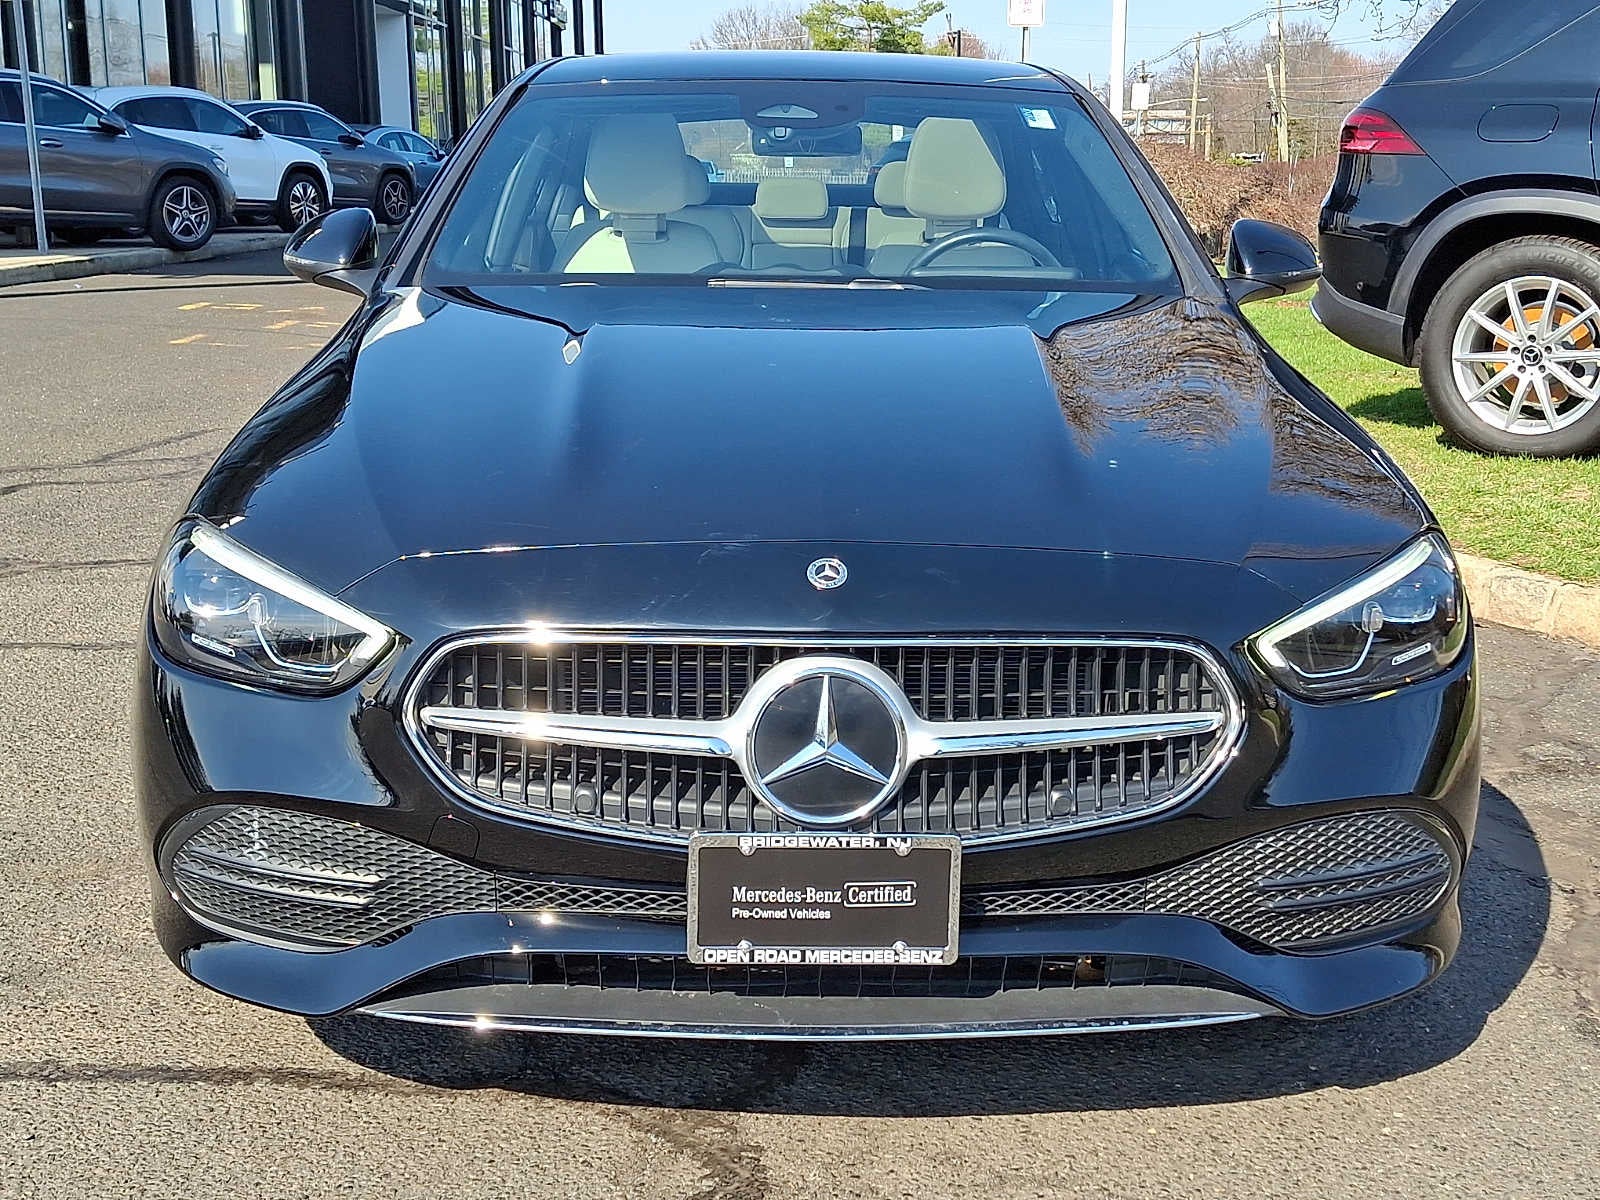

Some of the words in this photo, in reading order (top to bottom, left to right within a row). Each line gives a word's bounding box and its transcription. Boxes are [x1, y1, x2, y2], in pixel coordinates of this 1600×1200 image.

[886, 837, 912, 848] NJ
[732, 886, 842, 903] Mercedes-Benz
[848, 886, 912, 903] Certified
[731, 907, 787, 919] Pre-Owned
[789, 908, 831, 919] Vehicles
[704, 949, 750, 963] OPEN
[753, 949, 802, 963] ROAD
[804, 949, 944, 964] MERCEDES-BENZ
